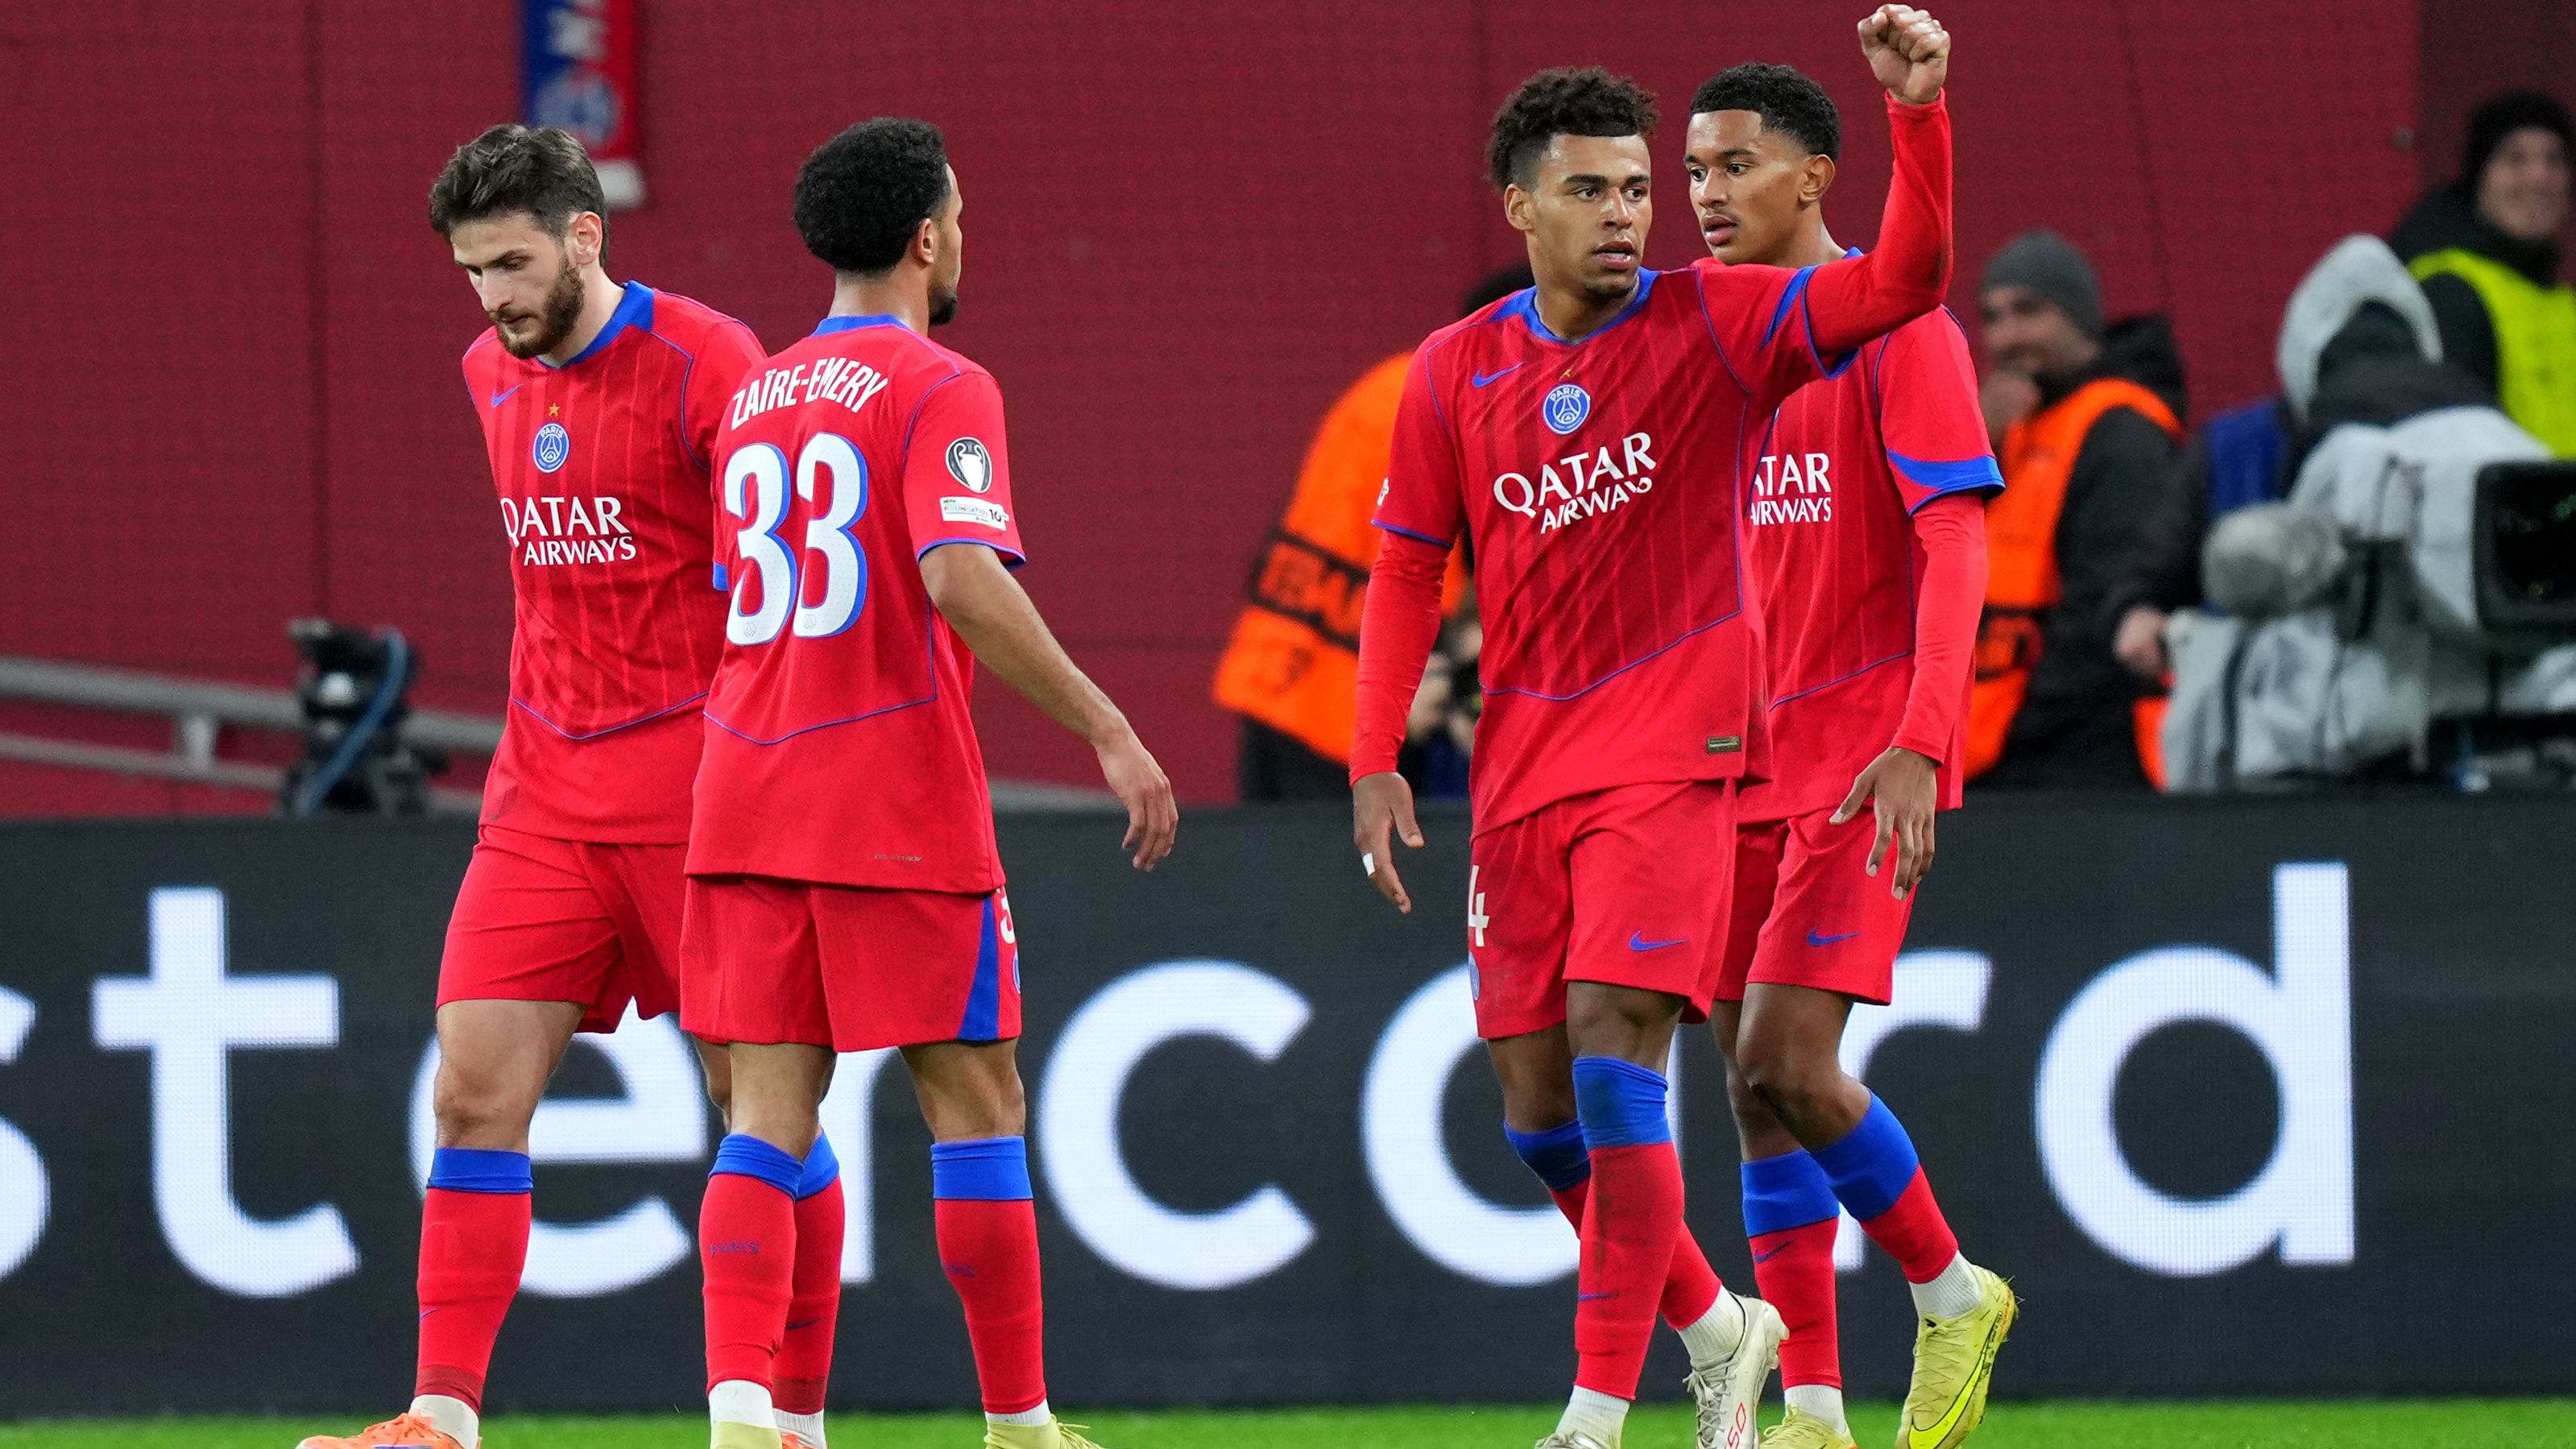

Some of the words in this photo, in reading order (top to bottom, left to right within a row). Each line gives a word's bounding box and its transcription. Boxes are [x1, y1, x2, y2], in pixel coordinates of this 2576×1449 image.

[731, 356, 888, 431] ZAÏRE-EMERY
[1549, 387, 1581, 402] PARIS
[540, 425, 564, 439] PARIS
[1493, 432, 1657, 519] QATAR
[499, 496, 631, 549] QATAR
[725, 431, 868, 647] 33
[524, 536, 636, 566] AIRWAYS
[709, 1240, 760, 1258] PARIS
